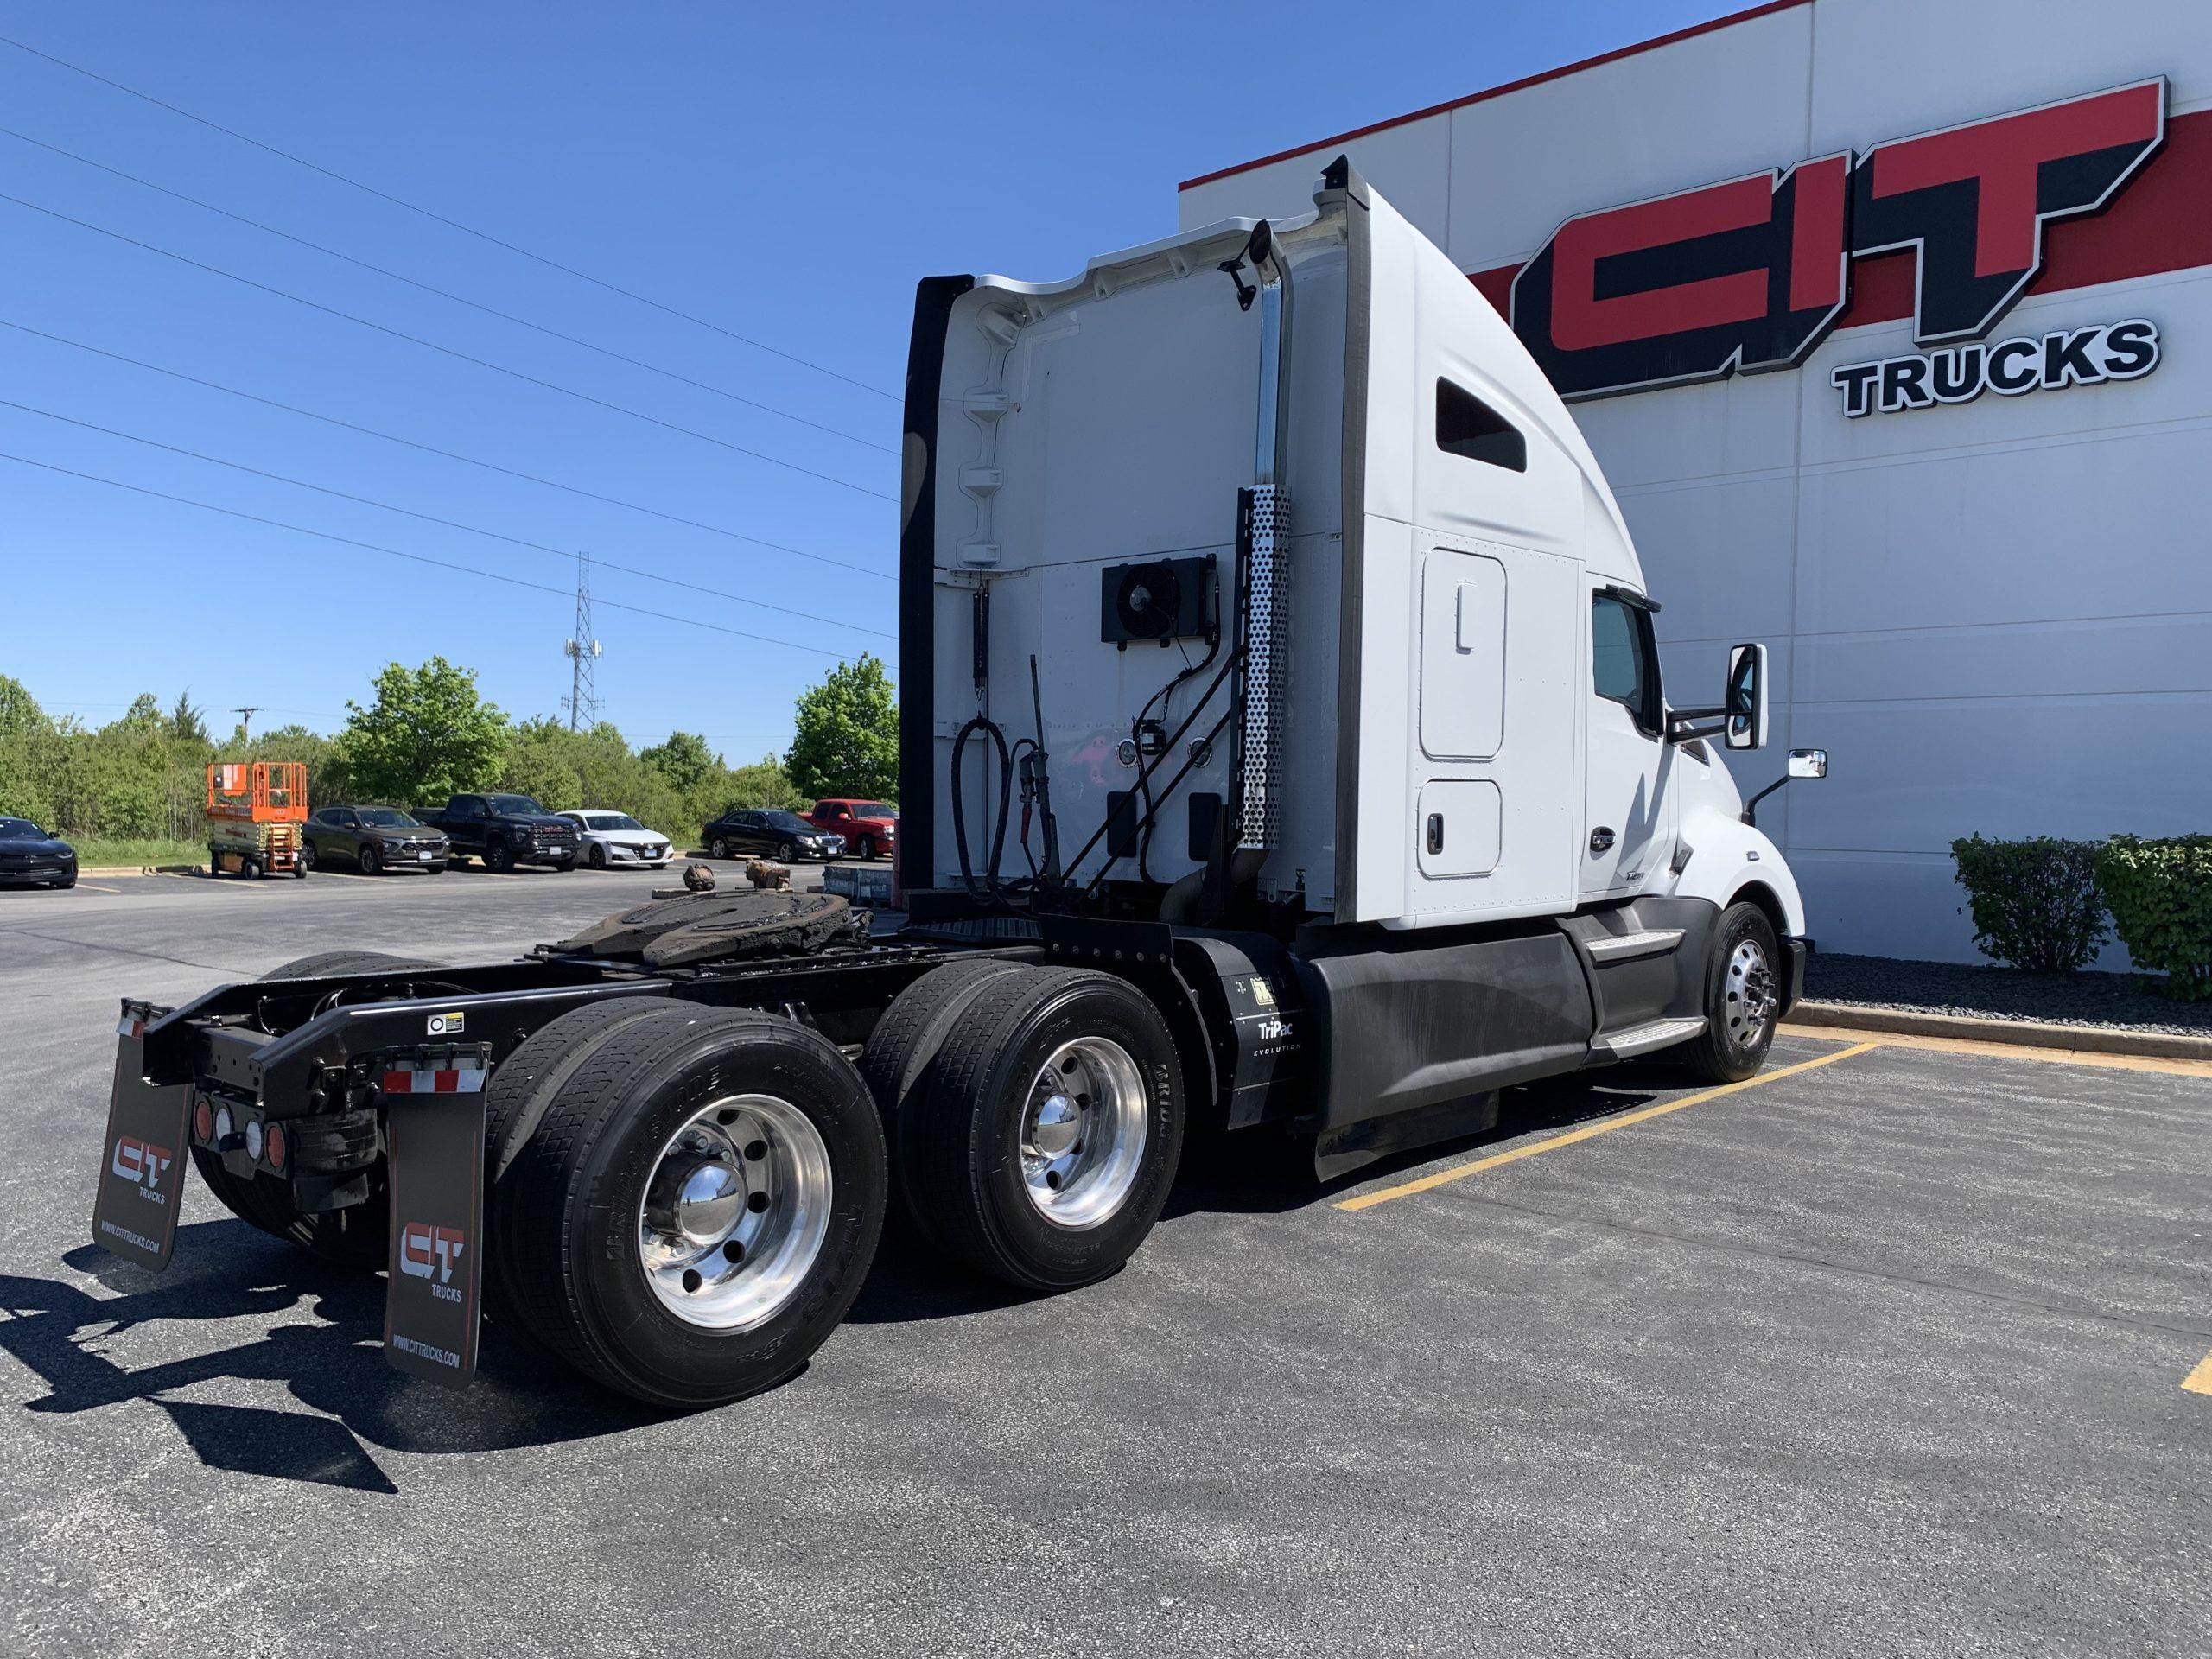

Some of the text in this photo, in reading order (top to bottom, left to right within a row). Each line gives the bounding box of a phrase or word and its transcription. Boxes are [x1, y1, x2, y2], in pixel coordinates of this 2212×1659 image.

[1512, 75, 2166, 401] CIT
[1830, 318, 2161, 417] TRUCKS
[1258, 1020, 1294, 1040] TriPac
[1253, 1043, 1301, 1057] EVOLUTION
[112, 1137, 171, 1189] CIT
[139, 1186, 166, 1205] TRUCKS
[101, 1219, 160, 1254] WWW.CITTRUCKS.COM
[400, 1221, 464, 1284] CIT
[432, 1284, 461, 1303] TRUCKS
[393, 1333, 460, 1369] WWW.CITTRUCKS.COM
